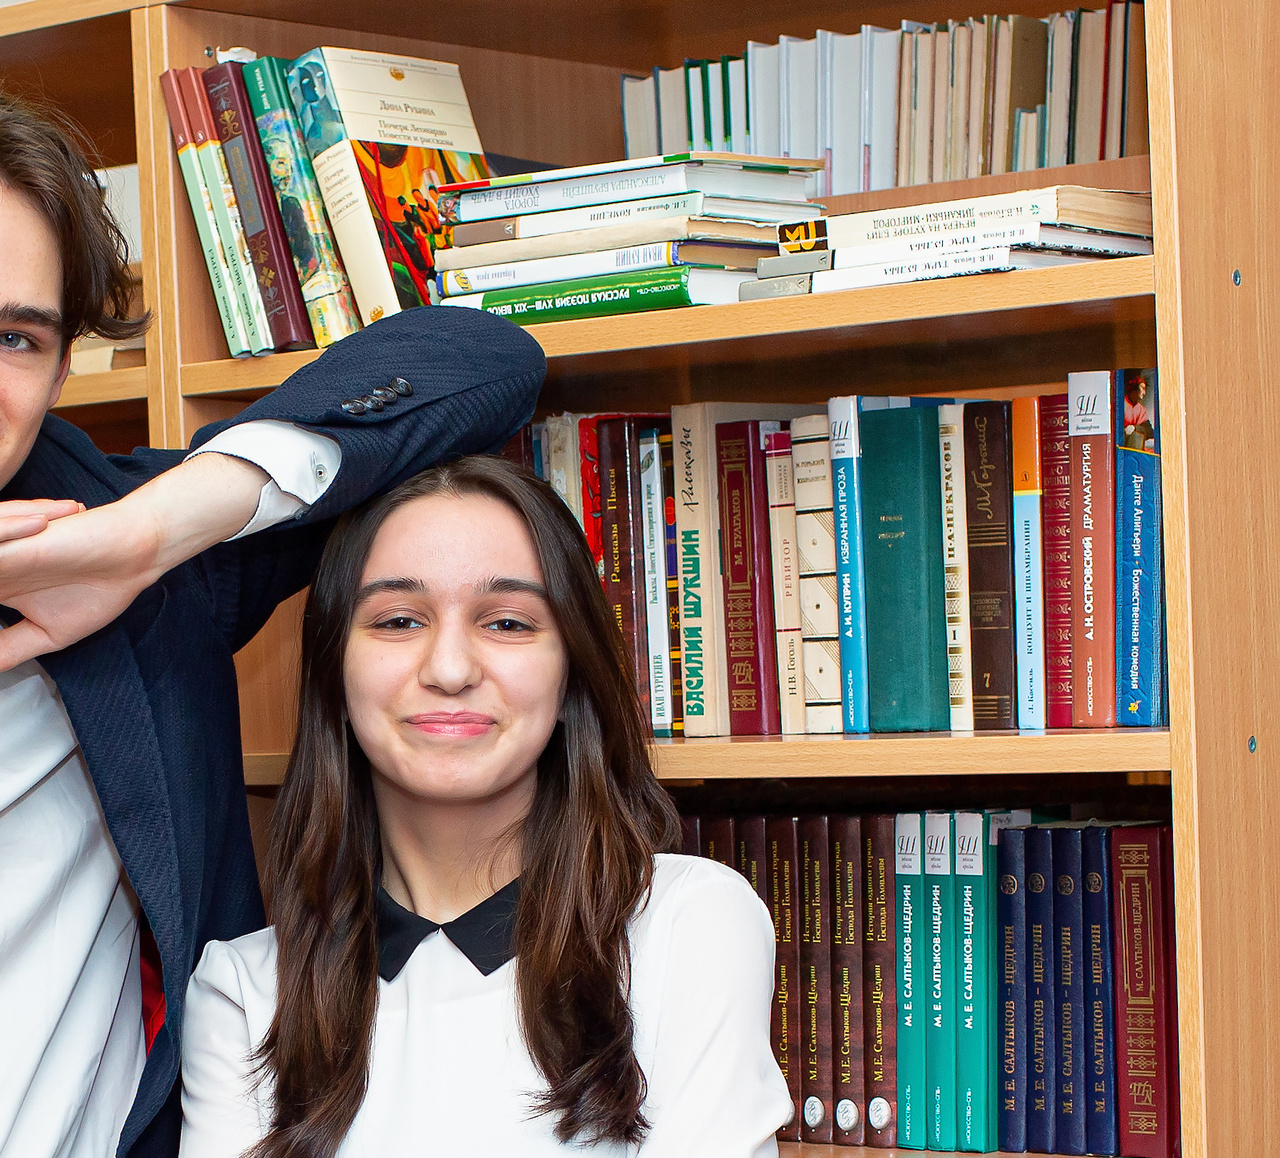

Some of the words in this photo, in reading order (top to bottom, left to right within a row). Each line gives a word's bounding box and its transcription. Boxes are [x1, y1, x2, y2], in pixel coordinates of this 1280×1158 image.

[380, 99, 401, 111] Дина
[610, 174, 666, 189] АЛЕКСАНДРА
[505, 184, 540, 198] УХОДИТ
[562, 181, 608, 198] БРУШТЕЙН
[504, 197, 540, 210] ДОРОГА
[590, 209, 631, 221] КОМЕДИИ
[892, 223, 926, 236] ХУТОРЕ
[927, 223, 941, 232] НА
[943, 218, 975, 230] ВЕЧЕРА
[866, 228, 890, 240] БЛИЗ
[947, 236, 976, 246] ТАРАС
[909, 239, 945, 251] БУЛЬБА
[883, 263, 918, 276] БУЛЬБА
[921, 260, 949, 271] ТАРАС
[555, 293, 589, 306] ПОЭЗИЯ
[591, 288, 629, 302] РУССКАЯ
[680, 426, 700, 512] Рассказы
[837, 467, 847, 502] ПРОЗА
[1081, 443, 1094, 530] ДРАМАТУРГИЯ
[1132, 475, 1143, 505] Данте
[731, 489, 743, 547] БУЛГАКОВ
[838, 505, 850, 564] ИЗБРАННАЯ
[1132, 509, 1144, 557] Алигьери
[610, 524, 621, 583] Рассказы
[734, 551, 743, 565] М.
[1023, 519, 1031, 594] ШВАМБРАНИЯ
[681, 530, 702, 618] ШУКШИН
[782, 538, 792, 597] РЕВИЗОР
[1081, 537, 1093, 613] ОСТРОВСКИЙ
[842, 573, 852, 613] КУПРИН
[1131, 568, 1143, 642] Божественная
[1083, 614, 1093, 624] Н.
[845, 627, 853, 637] А.
[1025, 608, 1033, 655] КОНДУИТ
[1083, 625, 1094, 640] А.
[786, 639, 796, 671] Гоголь
[653, 654, 664, 693] ТУРГЕНЕВ
[683, 627, 705, 716] ВАСИЛИЙ
[1130, 646, 1139, 689] комедия
[984, 673, 991, 688] 7
[655, 696, 665, 717] ИВАН
[877, 858, 886, 904] Головлевы
[866, 903, 874, 942] История
[877, 907, 887, 942] Господа
[1131, 883, 1144, 979] САЛТЫКОВ-ЩЕДРИН
[932, 886, 943, 998] САЛТЫКОВ-ЩЕДРИН
[963, 886, 974, 999] САЛТЫКОВ-ЩЕДРИН
[1136, 981, 1143, 991] М.
[840, 967, 852, 1055] Салтыков-Щедрин
[872, 965, 885, 1052] Салтыков-Щедрин
[933, 1000, 941, 1011] Е.
[965, 1001, 972, 1012] Е.
[934, 1015, 941, 1027] М.
[965, 1016, 973, 1029] М.
[841, 1057, 850, 1067] Е.
[874, 1054, 882, 1065] Е.
[841, 1070, 851, 1083] М.
[874, 1068, 883, 1081] М.
[1063, 1081, 1073, 1093] Е.
[1094, 1080, 1104, 1092] Е.
[1063, 1098, 1073, 1113] М.
[1095, 1096, 1105, 1112] М.
